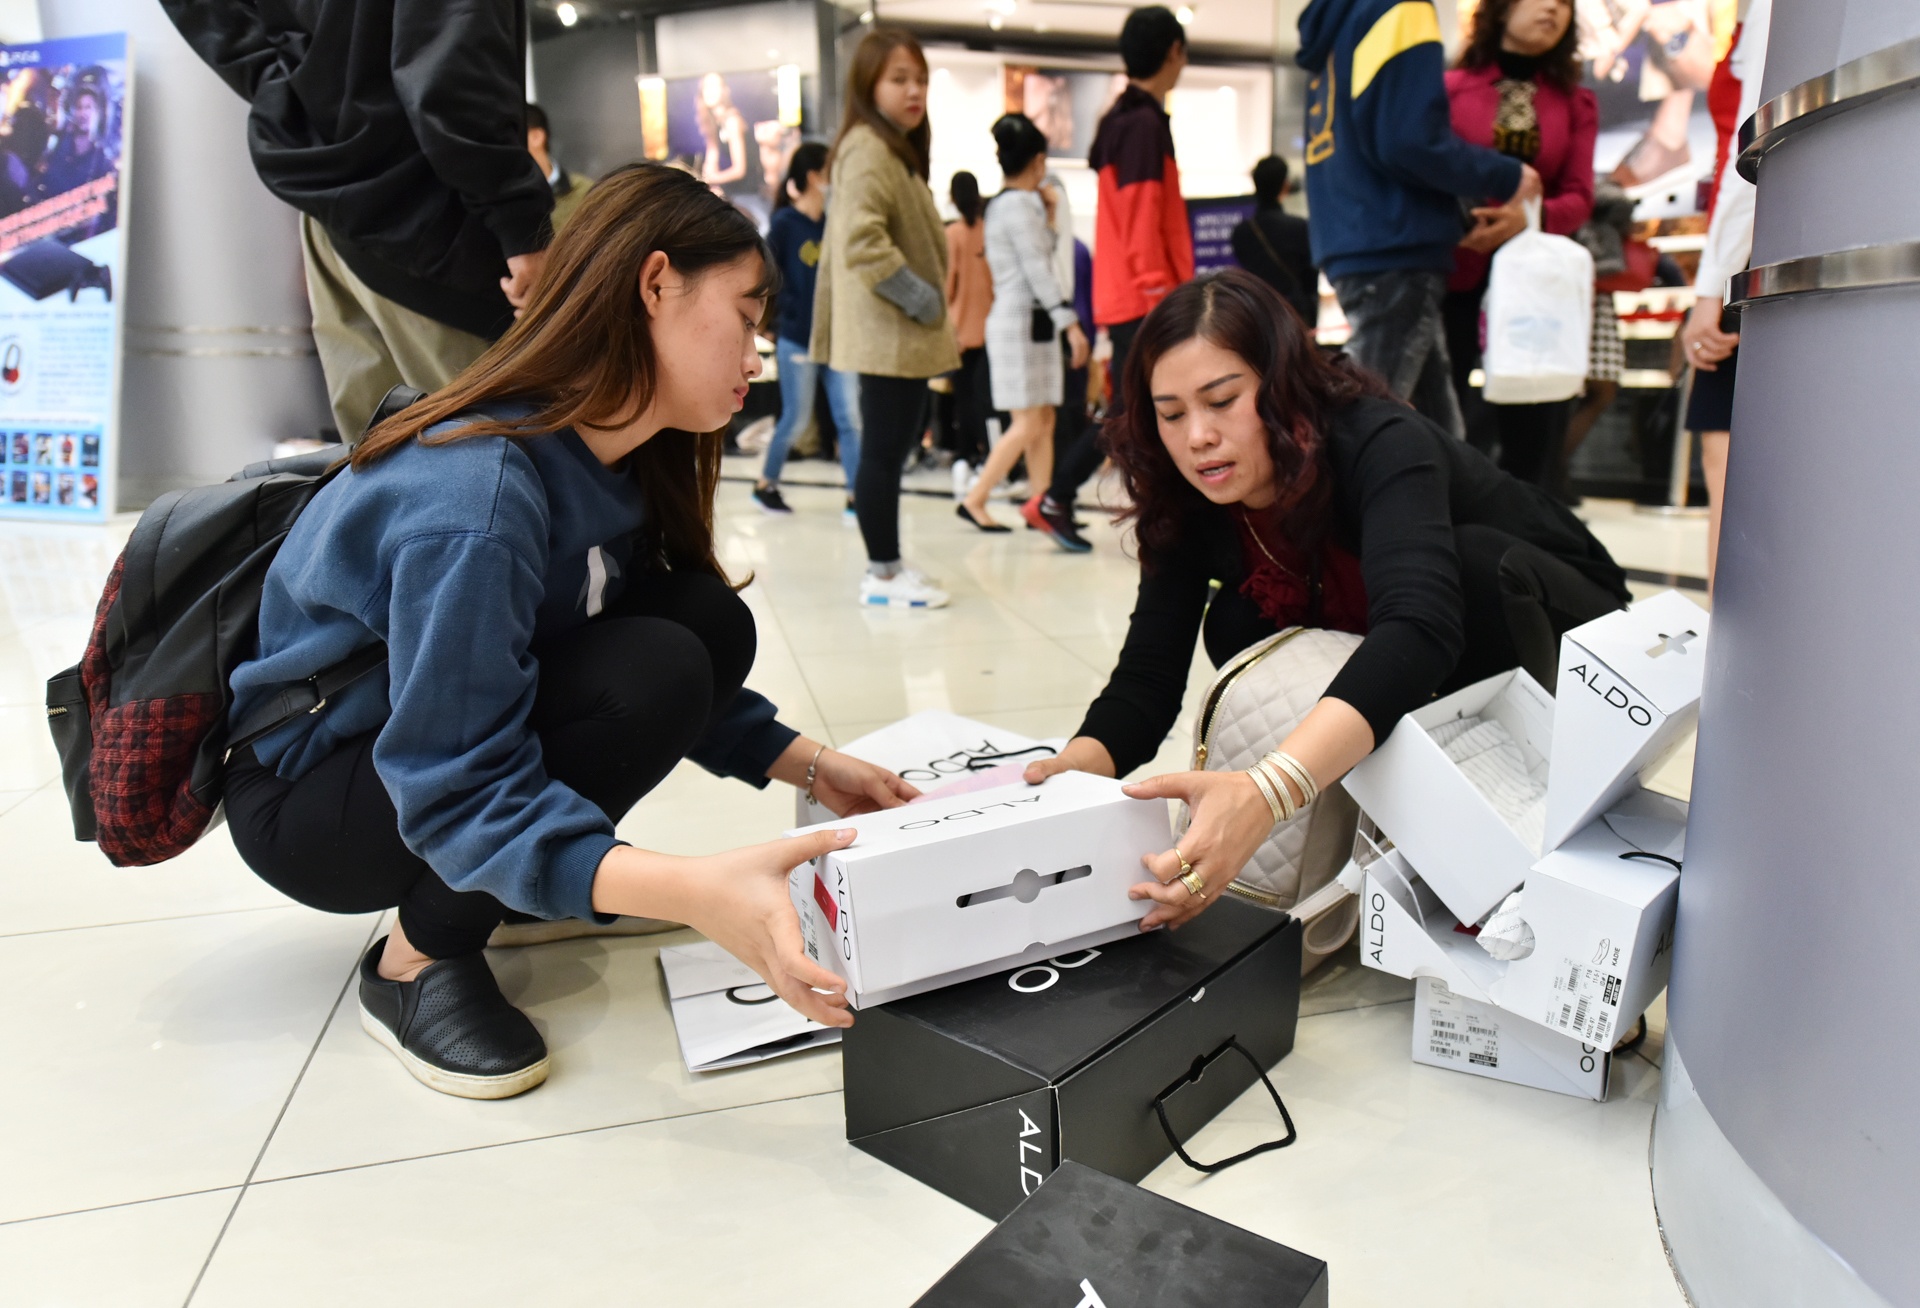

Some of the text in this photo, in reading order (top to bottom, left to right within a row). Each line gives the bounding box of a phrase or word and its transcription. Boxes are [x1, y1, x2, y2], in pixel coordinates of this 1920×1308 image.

[1568, 664, 1652, 726] ALDO
[899, 795, 1040, 830] ALDO
[836, 866, 851, 960] ALDO
[1370, 893, 1385, 965] ALDO
[1612, 947, 1620, 966] KADIE
[1586, 1017, 1595, 1039] KADIE-97
